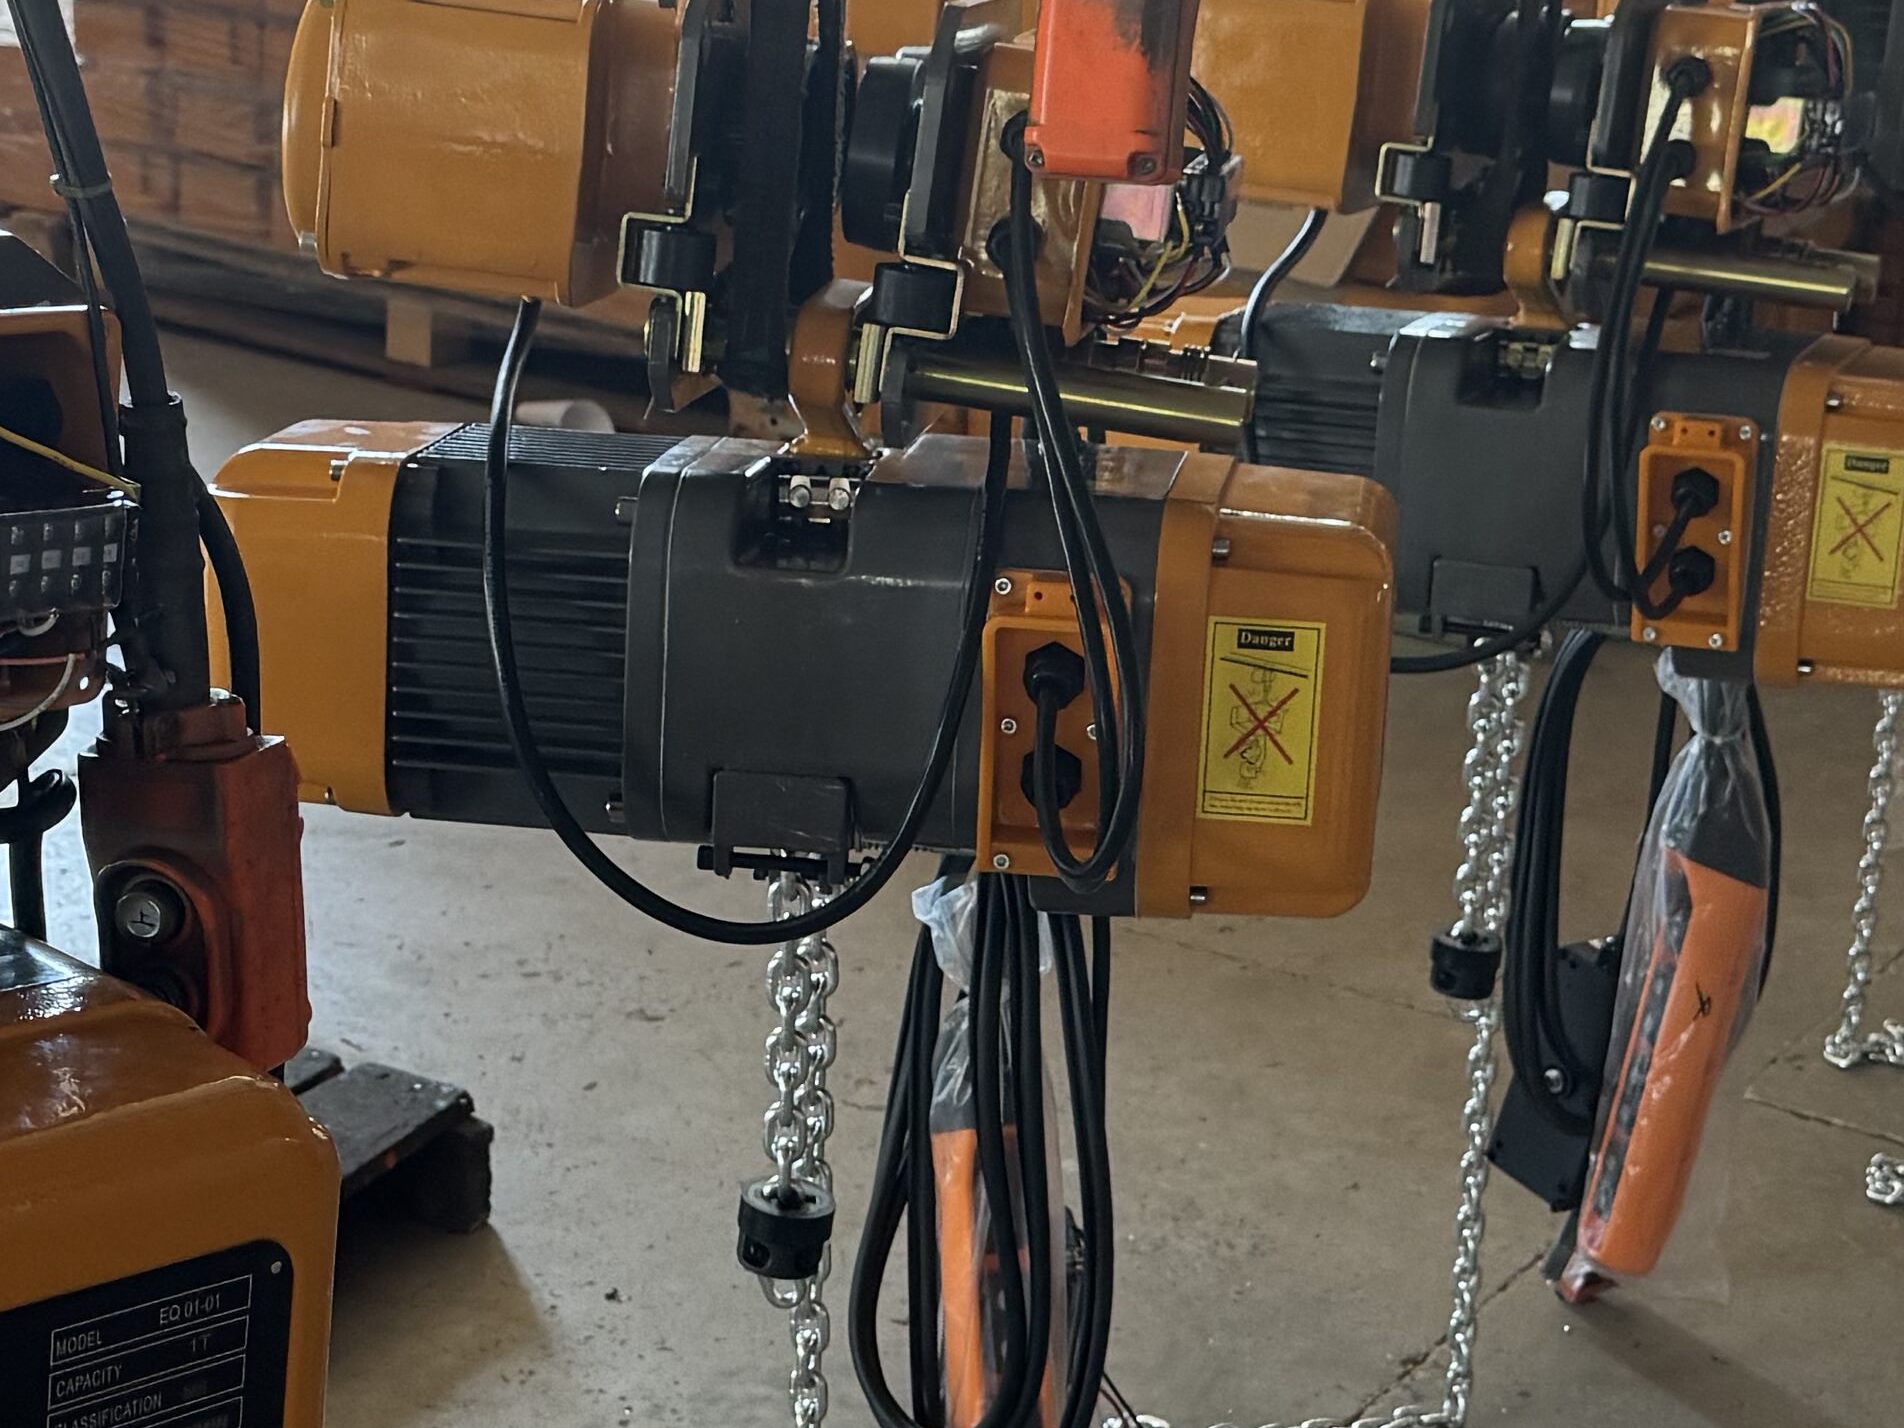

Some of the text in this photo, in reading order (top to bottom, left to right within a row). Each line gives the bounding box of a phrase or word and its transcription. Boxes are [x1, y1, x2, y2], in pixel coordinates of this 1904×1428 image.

[1240, 631, 1292, 648] Danger
[55, 1292, 222, 1359] MODEL EQ 01-01
[56, 1333, 211, 1398] CAPACITY 1T
